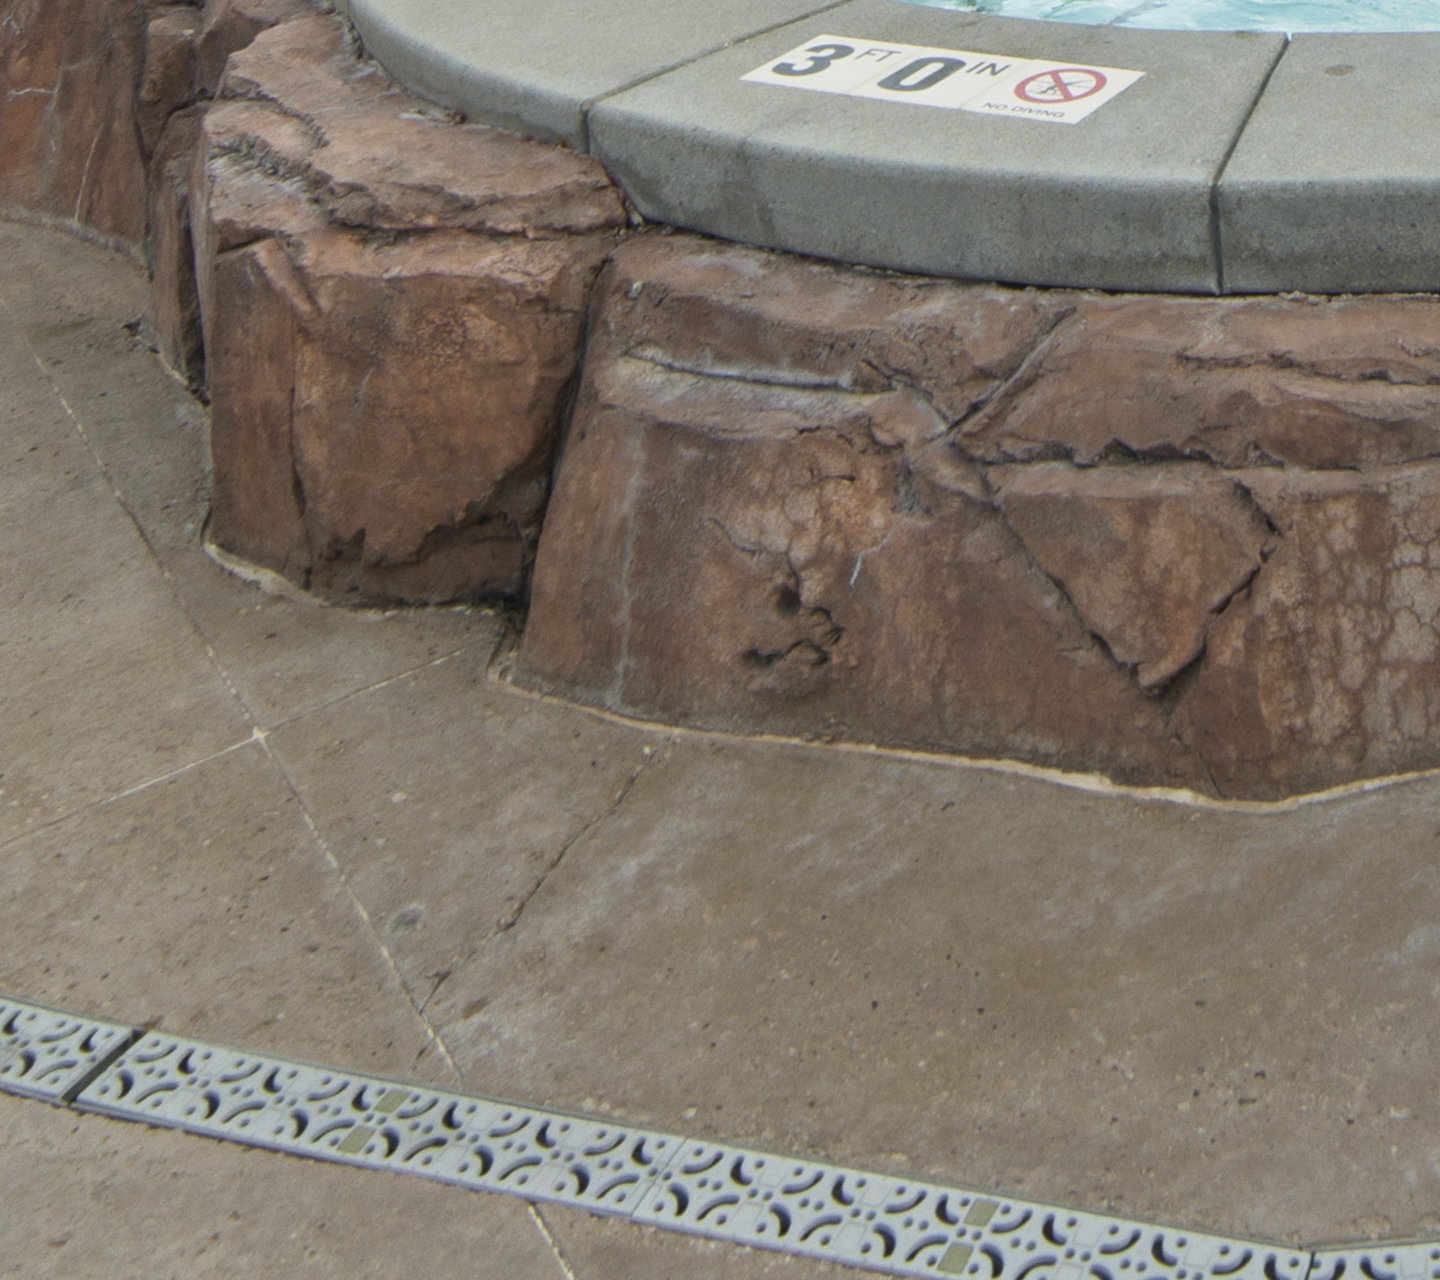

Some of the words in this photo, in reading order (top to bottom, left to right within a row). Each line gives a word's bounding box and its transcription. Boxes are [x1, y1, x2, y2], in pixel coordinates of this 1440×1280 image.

[771, 43, 855, 77] 3
[855, 48, 902, 62] FT
[877, 56, 966, 91] 0
[966, 61, 1010, 76] IN
[982, 102, 1009, 110] NO
[1011, 105, 1066, 118] DIVING
